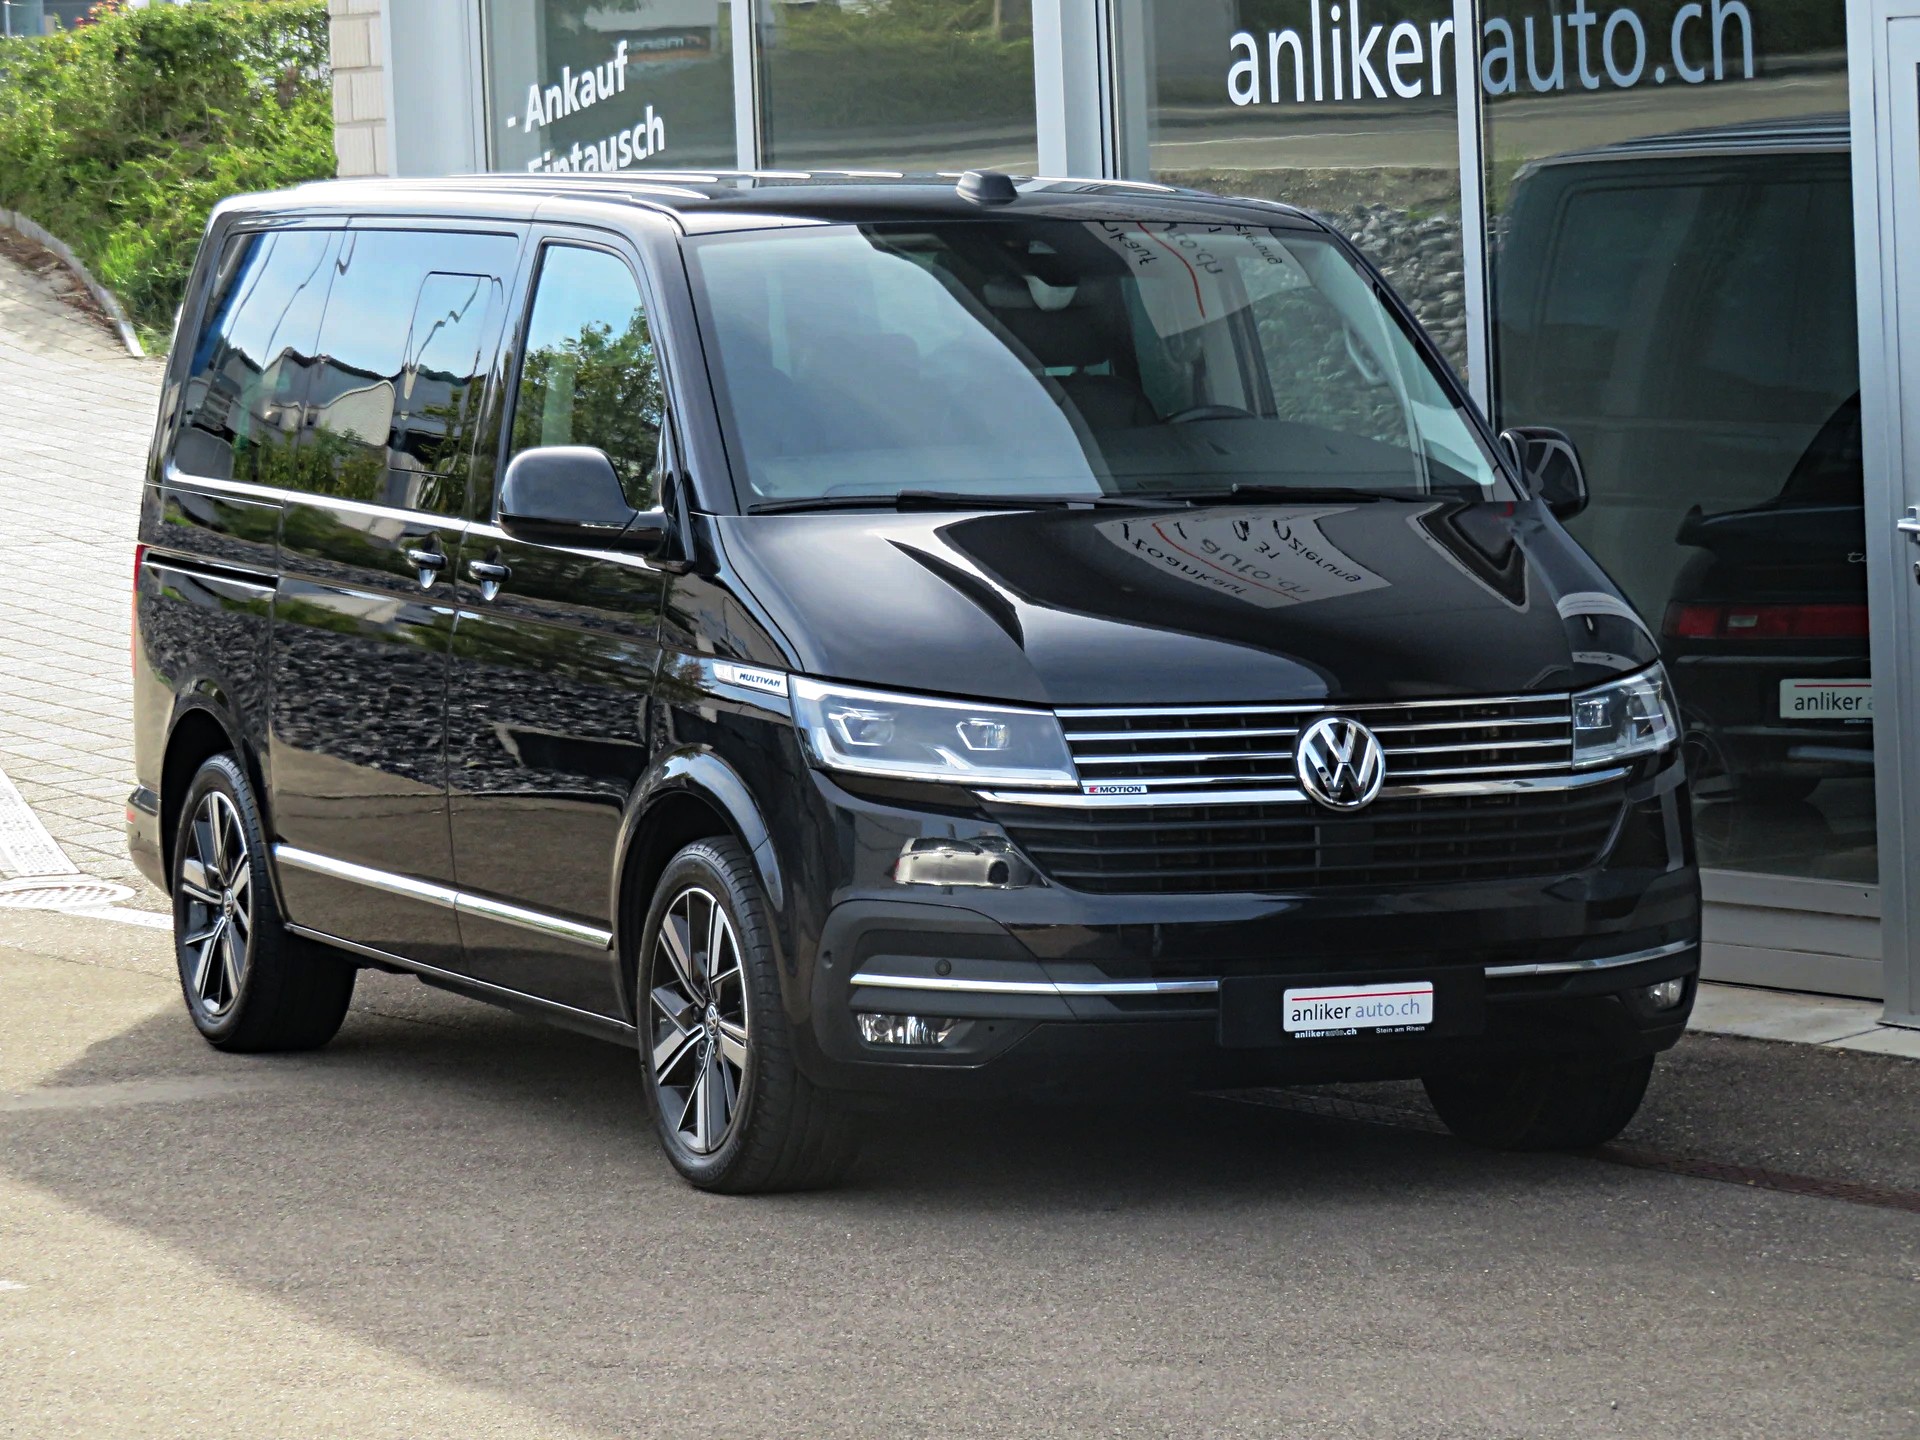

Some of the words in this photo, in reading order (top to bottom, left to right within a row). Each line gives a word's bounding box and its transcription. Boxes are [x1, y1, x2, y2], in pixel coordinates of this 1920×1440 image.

[1227, 0, 1454, 106] anliker
[1481, 0, 1755, 96] auto.ch
[524, 40, 628, 133] Ankauf
[527, 105, 665, 173] tausch
[739, 673, 781, 687] MULTIVAN
[1794, 692, 1863, 711] anliker
[1292, 1003, 1351, 1022] anliker
[1355, 998, 1420, 1018] auto.ch
